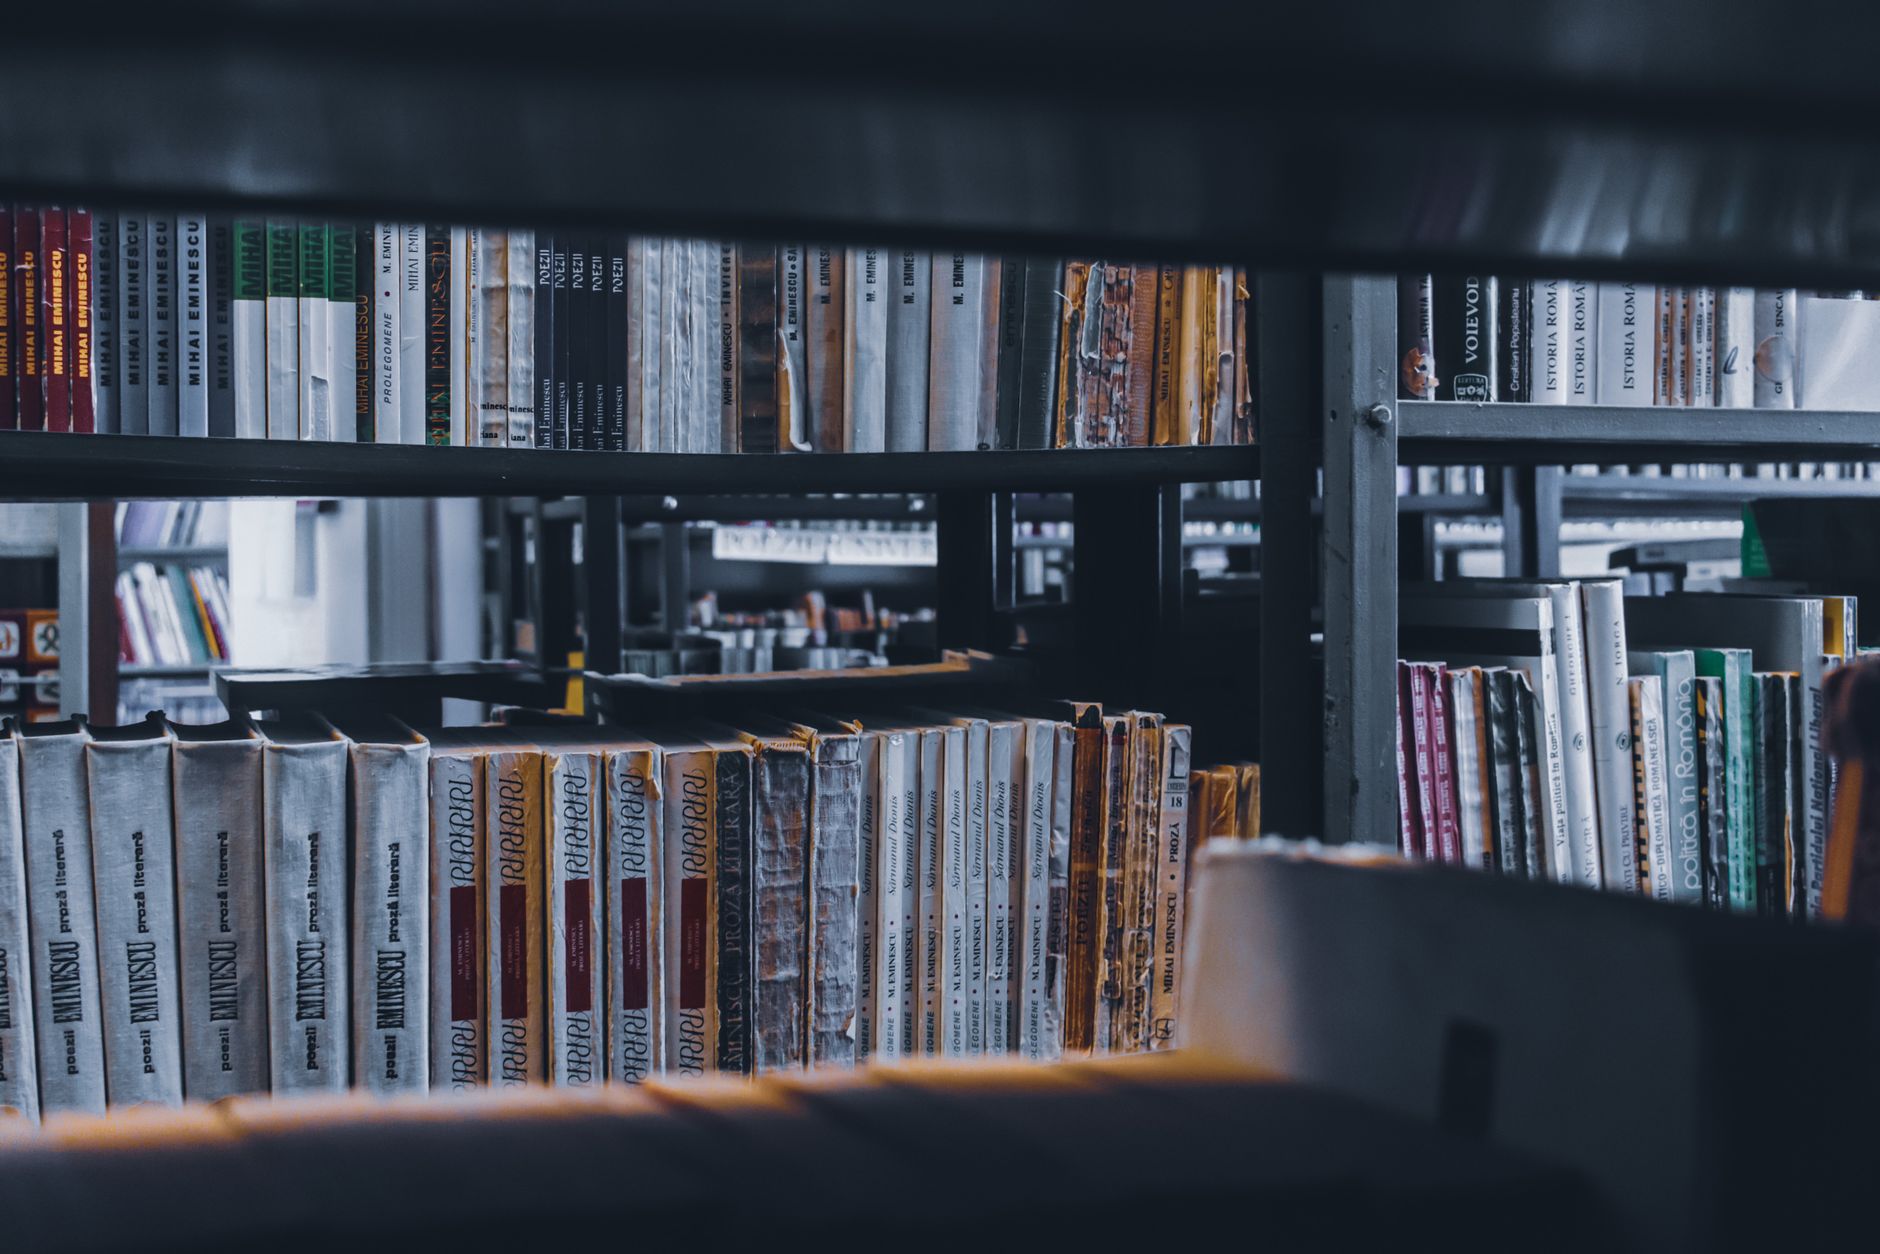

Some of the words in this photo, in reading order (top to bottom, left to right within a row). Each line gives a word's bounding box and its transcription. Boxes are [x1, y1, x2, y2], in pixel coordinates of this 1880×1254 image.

[24, 251, 35, 325] EMINESCU
[52, 250, 63, 325] EMINESCU
[77, 253, 88, 328] EMINESCU
[100, 222, 111, 320] EMINESCU
[127, 221, 139, 320] EMINESCU
[156, 222, 168, 321] EMINESCU
[188, 221, 199, 320] EMINESCU
[216, 227, 228, 324] EMINESCU
[383, 263, 392, 274] M.
[408, 258, 419, 292] MIHAI
[539, 249, 550, 285] POEZII
[555, 253, 565, 288] POEZII
[573, 253, 583, 288] POEZII
[592, 256, 602, 291] POEZII
[612, 258, 623, 292] POEZII
[788, 272, 797, 325] EMINESCU
[866, 290, 876, 302] M.
[904, 291, 914, 304] M.
[953, 292, 964, 305] M.
[25, 331, 36, 375] MIHAI
[53, 330, 63, 375] MIHAI
[78, 333, 89, 377] MIHAI
[356, 294, 368, 370] EMINESCU
[723, 323, 732, 372] EMINESCU
[100, 331, 112, 387] MIHAI
[128, 330, 140, 385] MIHAI
[157, 330, 169, 386] MIHAI
[189, 330, 200, 386] MIHAI
[217, 335, 229, 390] MIHAI
[383, 313, 393, 404] PROLEGOMENE
[1510, 351, 1520, 391] Cristian
[1546, 332, 1557, 390] ISTORIA
[1574, 337, 1586, 395] ISTORIA
[1623, 331, 1635, 389] ISTORIA
[356, 374, 369, 414] MIHAI
[538, 379, 550, 429] Eminescu
[554, 381, 566, 431] Eminescu
[572, 381, 584, 431] Eminescu
[592, 384, 604, 434] Eminescu
[611, 386, 623, 435] Eminescu
[723, 377, 732, 406] MIHAI
[1566, 627, 1577, 695] GHEORGHE
[1612, 620, 1623, 666] IORGA
[1673, 679, 1695, 778] România
[861, 794, 873, 834] Dionis
[887, 795, 899, 834] Dionis
[903, 790, 915, 830] Dionis
[926, 790, 938, 830] Dionis
[950, 789, 962, 829] Dionis
[971, 779, 983, 818] Dionis
[994, 780, 1006, 820] Dionis
[1008, 782, 1021, 821] Dionis
[1033, 782, 1046, 820] Dionis
[971, 821, 983, 880] Sărmanul
[994, 822, 1006, 880] Sărmanul
[1031, 822, 1045, 880] Sărmanul
[1168, 822, 1180, 863] PROZĂ
[1619, 805, 1632, 847] PRIVIRE
[1680, 811, 1701, 890] politică
[53, 829, 66, 887] literară
[132, 831, 145, 887] literară
[216, 831, 229, 887] literară
[306, 832, 319, 887] literară
[387, 842, 400, 898] literară
[861, 836, 873, 896] Sărmanul
[887, 836, 898, 896] Sărmanul
[903, 832, 915, 891] Sărmanul
[926, 832, 938, 891] Sărmanul
[950, 832, 962, 891] Sărmanul
[1622, 851, 1632, 867] CU
[1809, 816, 1825, 890] Partidului
[55, 889, 73, 934] proză
[134, 891, 150, 934] proză
[217, 891, 231, 933] proză
[307, 891, 320, 933] proză
[388, 901, 401, 943] proză
[1164, 891, 1178, 954] EMINESCU
[862, 932, 872, 985] EMINESCU
[887, 932, 897, 984] EMINESCU
[904, 926, 914, 979] EMINESCU
[926, 926, 936, 979] EMINESCU
[952, 926, 962, 978] EMINESCU
[972, 915, 982, 966] EMINESCU
[994, 916, 1004, 964] EMINESCU
[1031, 916, 1042, 964] EMINESCU
[48, 940, 83, 1024] EMINESCU
[126, 941, 160, 1024] EMINESCU
[208, 941, 238, 1022] EMINESCU
[296, 940, 326, 1022] EMINESCU
[376, 949, 406, 1030] EMINESCU
[862, 985, 872, 998] M.
[887, 985, 897, 998] M.
[904, 979, 913, 992] M.
[927, 979, 936, 992] M.
[952, 978, 961, 991] M.
[972, 967, 981, 981] M.
[1031, 965, 1041, 981] M.
[1163, 958, 1175, 994] MIHAI
[64, 1030, 79, 1075] poezii
[140, 1030, 155, 1074] poezii
[219, 1027, 232, 1071] poezii
[305, 1026, 320, 1070] poezii
[385, 1035, 398, 1079] poezii
